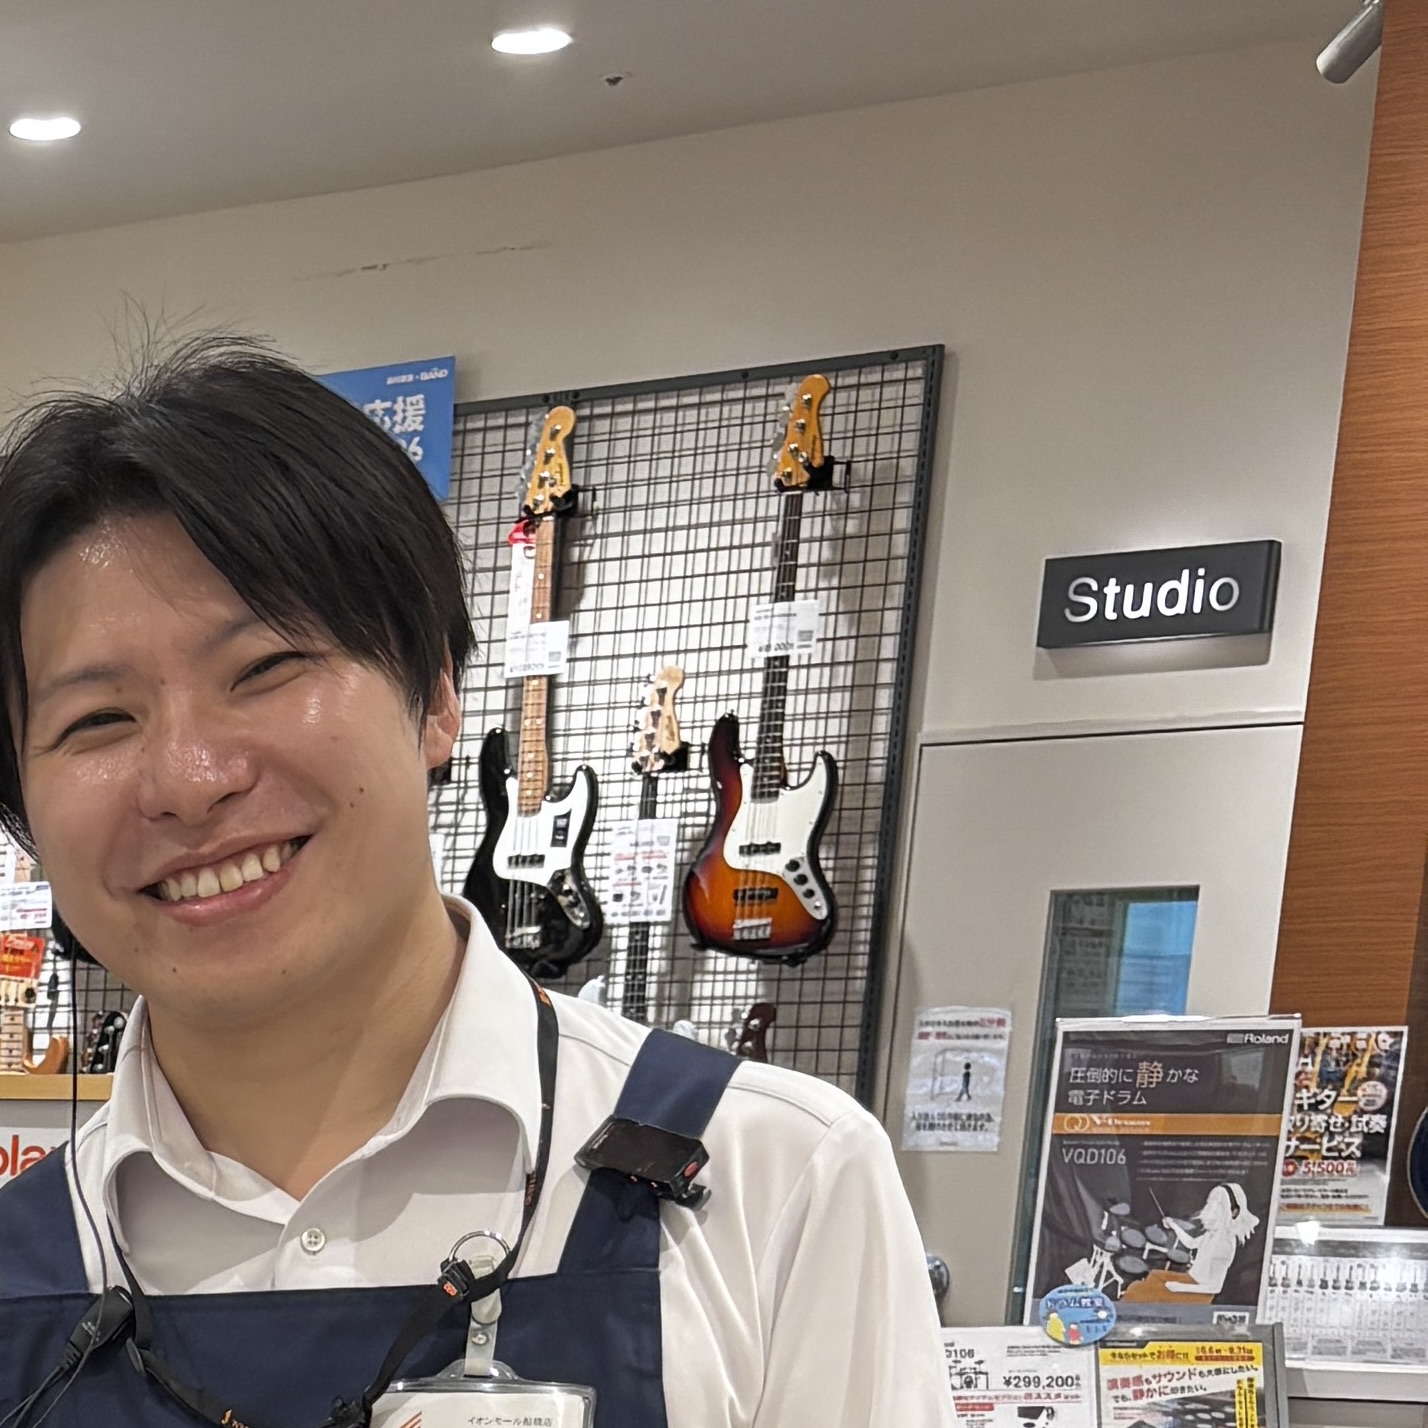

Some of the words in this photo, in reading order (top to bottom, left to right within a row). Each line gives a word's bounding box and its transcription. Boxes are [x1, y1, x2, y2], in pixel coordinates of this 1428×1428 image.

[1063, 567, 1240, 623] Studio
[1245, 1033, 1289, 1044] Roland
[1068, 1060, 1200, 1089] 圧倒的に静かな
[1067, 1089, 1147, 1106] 電子ドラム
[1062, 1147, 1127, 1165] VQD106
[1002, 1375, 1075, 1389] ¥299,200
